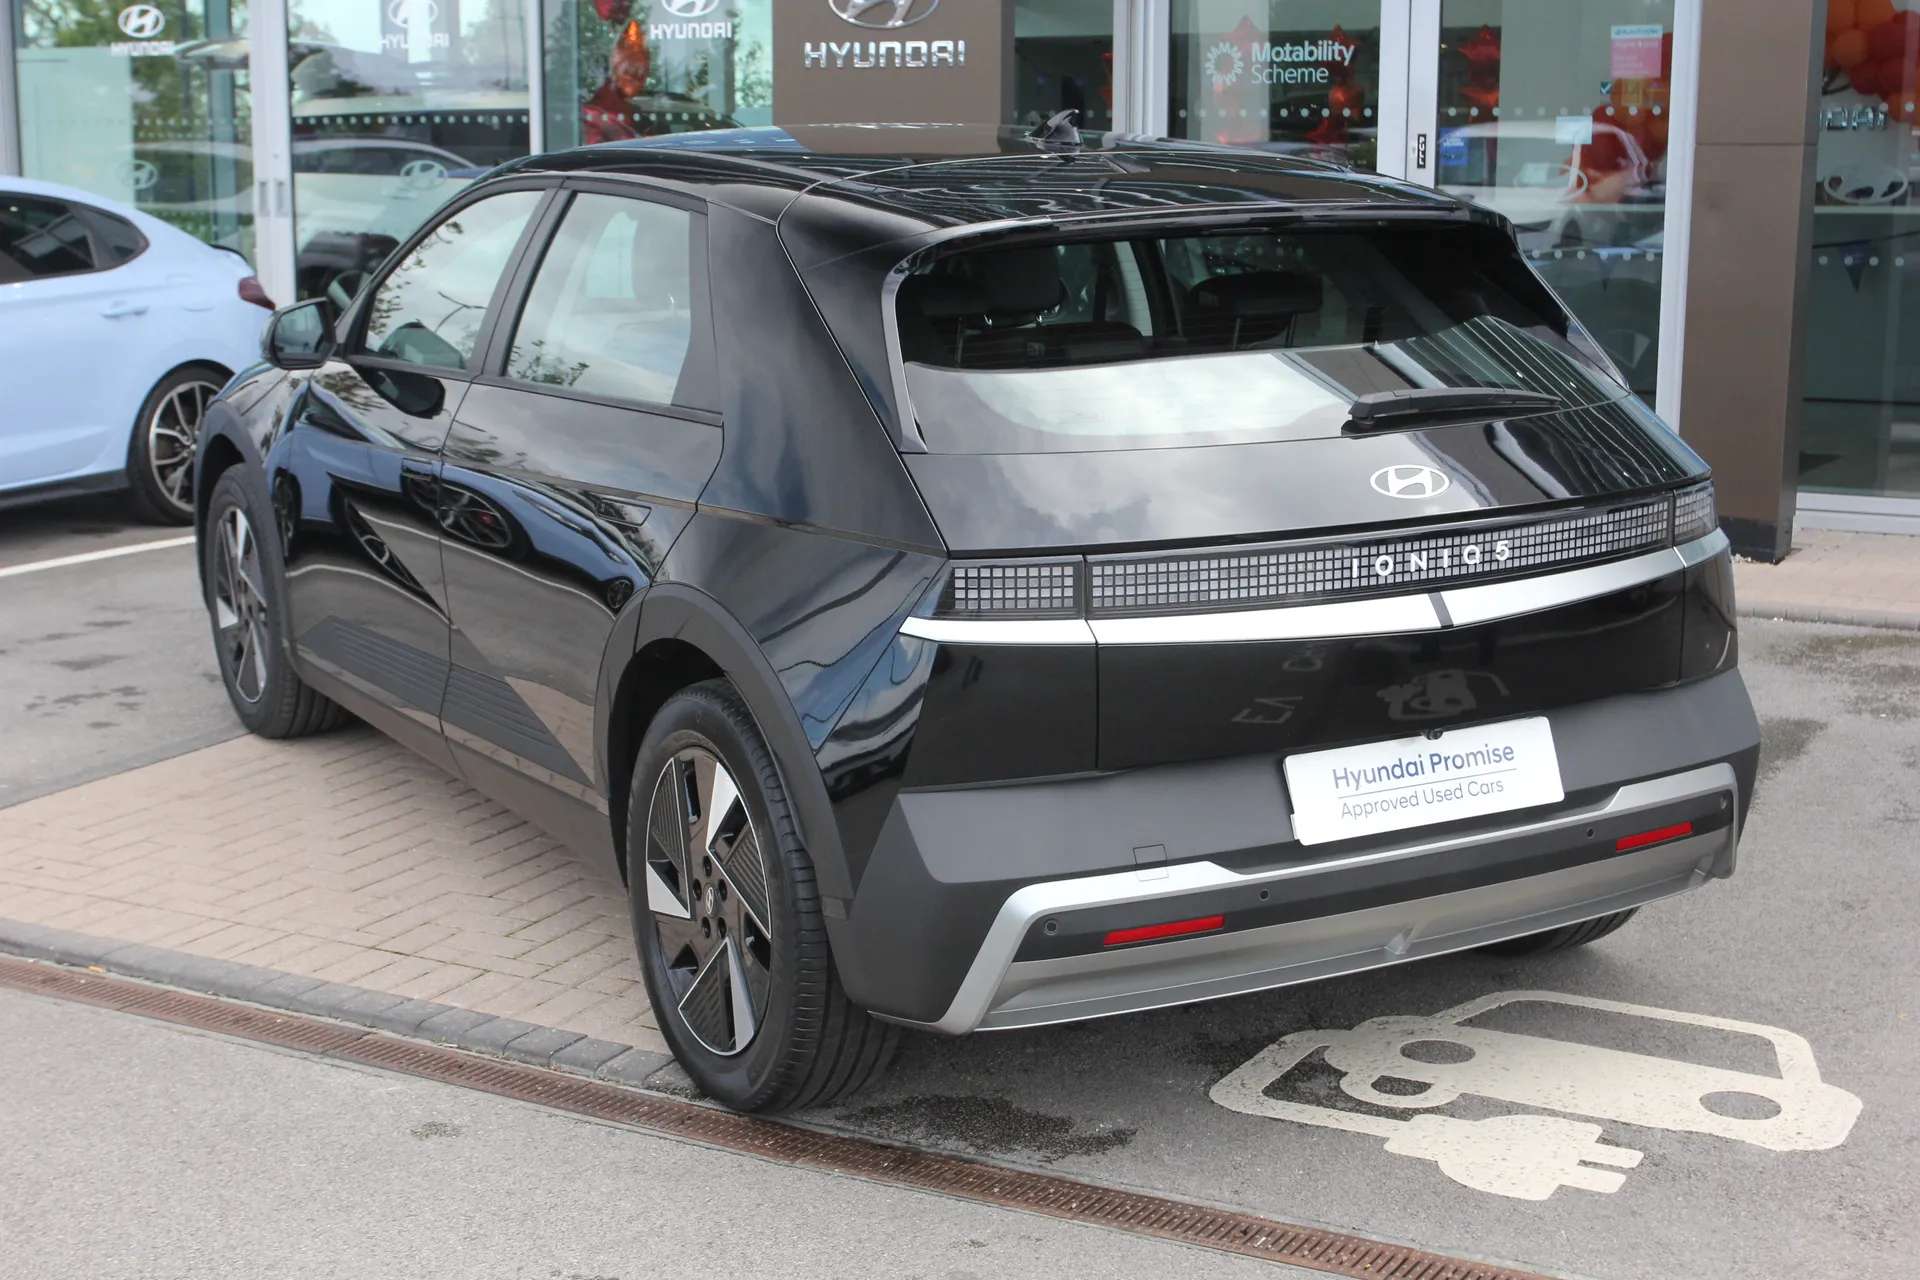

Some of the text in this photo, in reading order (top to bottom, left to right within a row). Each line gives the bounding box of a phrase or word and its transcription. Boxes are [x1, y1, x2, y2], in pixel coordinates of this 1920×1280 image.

[650, 22, 733, 40] HYUNDAI
[804, 40, 966, 68] HYUNDAI
[1251, 40, 1356, 67] Motability
[1251, 64, 1329, 85] Scheme
[1418, 135, 1426, 166] PULL
[1352, 540, 1509, 578] IONIQ 5
[1332, 744, 1515, 791] Hyundai Promise
[1340, 778, 1505, 820] Approved Used Cars
